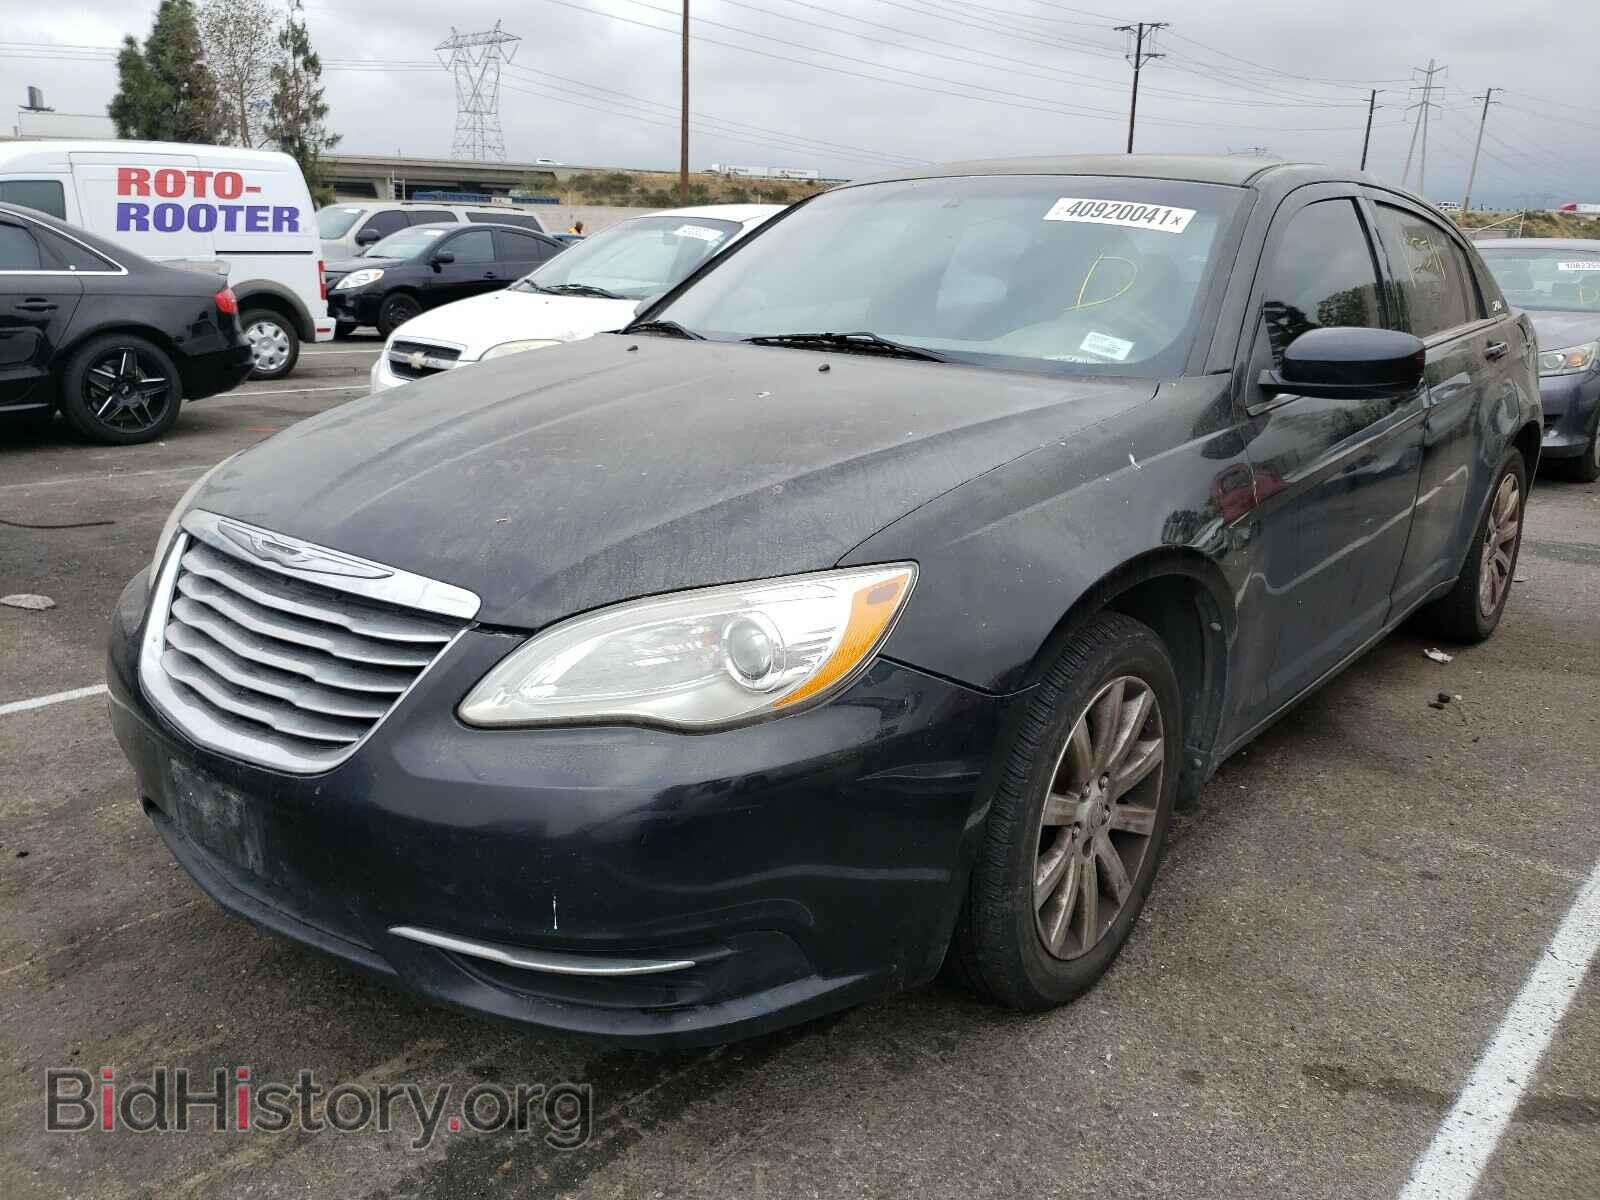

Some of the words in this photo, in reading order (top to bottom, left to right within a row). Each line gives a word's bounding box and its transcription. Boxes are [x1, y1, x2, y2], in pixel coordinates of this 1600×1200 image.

[117, 168, 262, 200] ROTO-
[116, 203, 300, 233] ROOTER
[1066, 201, 1172, 225] 40920041
